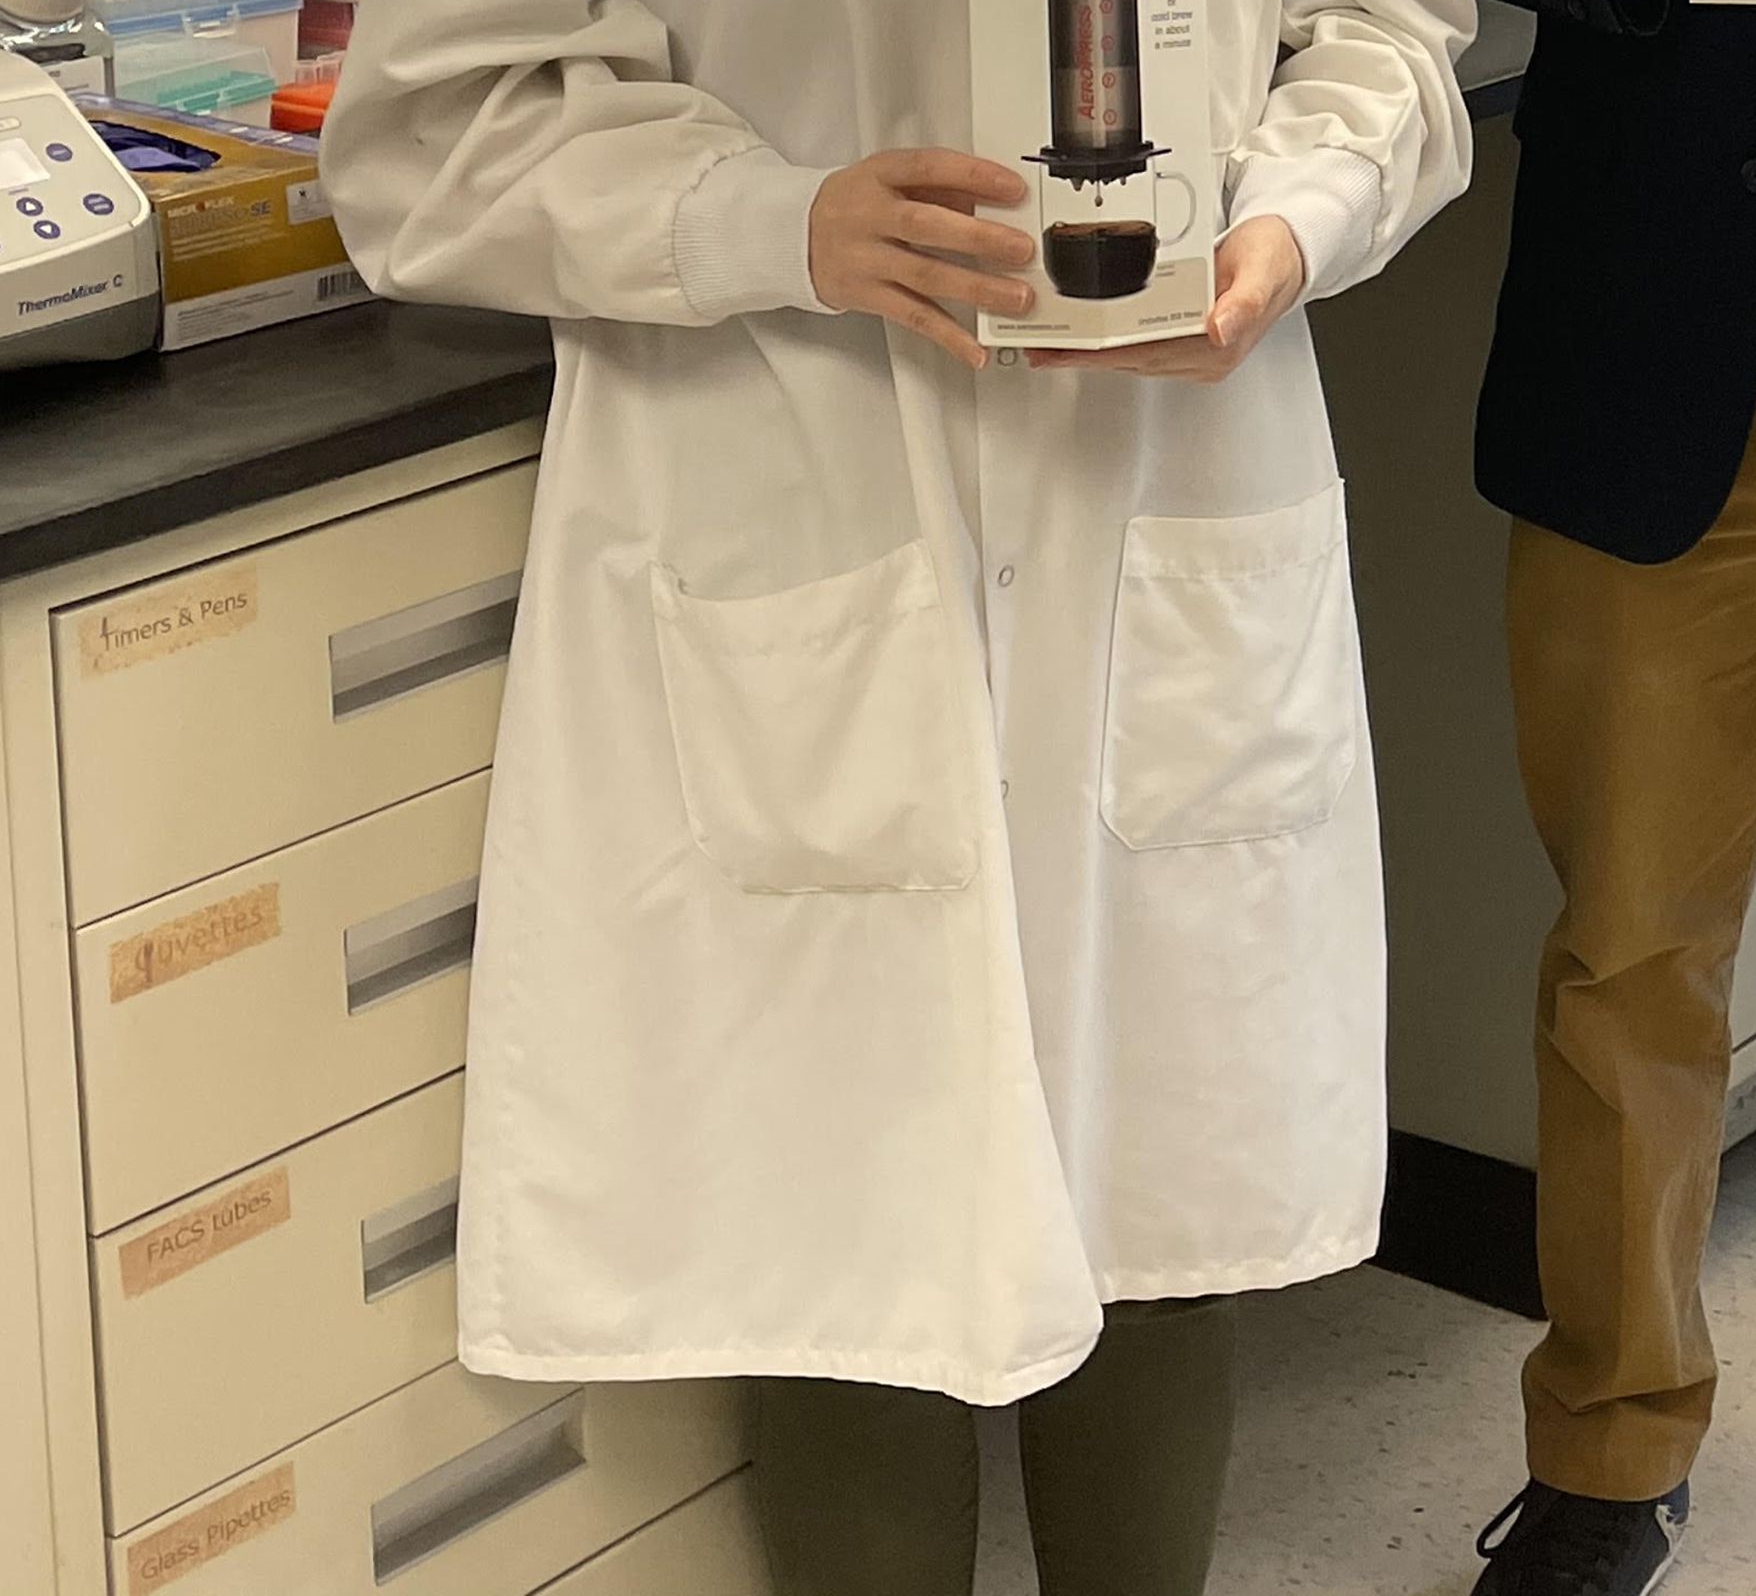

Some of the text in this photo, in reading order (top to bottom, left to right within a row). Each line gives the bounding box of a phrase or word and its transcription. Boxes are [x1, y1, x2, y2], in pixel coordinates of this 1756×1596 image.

[18, 274, 123, 316] ThermoMixer C
[177, 608, 195, 628] &
[200, 592, 248, 621] Pens
[147, 1222, 206, 1265] FACS
[141, 1540, 200, 1581] Glass
